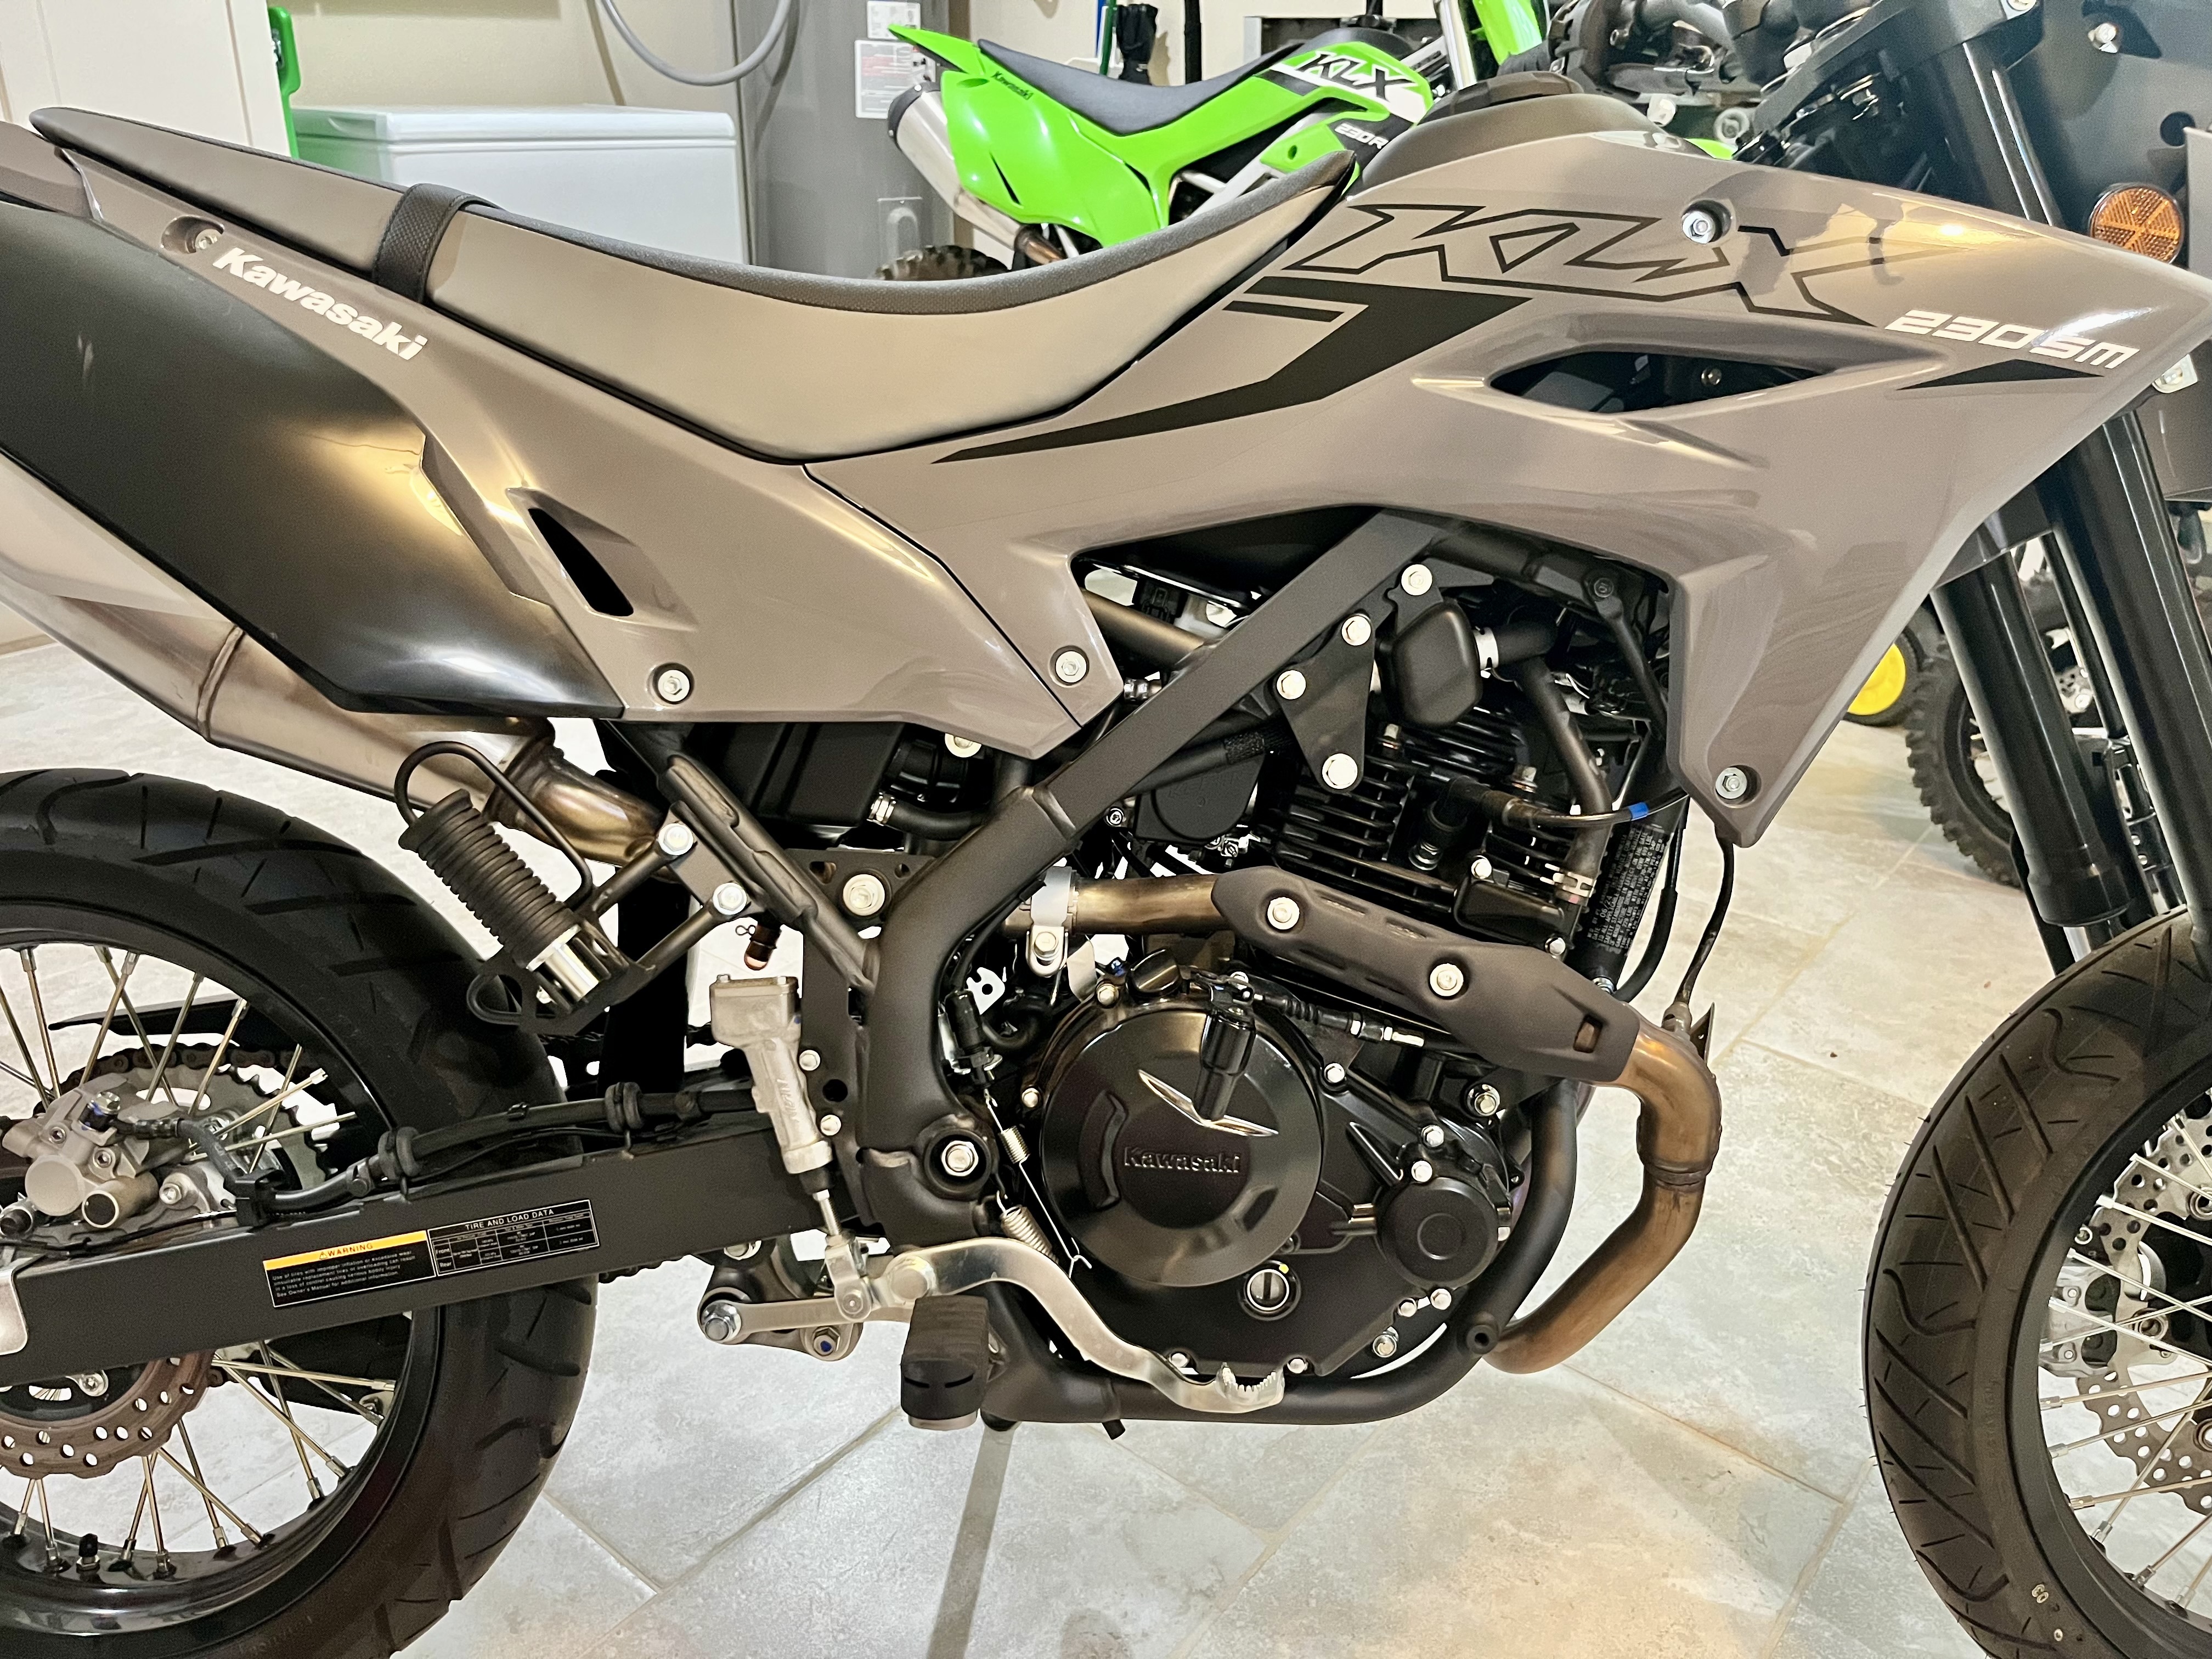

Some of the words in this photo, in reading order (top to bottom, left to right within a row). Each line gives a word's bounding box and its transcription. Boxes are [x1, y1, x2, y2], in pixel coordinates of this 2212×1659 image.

[990, 71, 1034, 100] Kawasaki
[1295, 53, 1417, 103] KLX
[1334, 122, 1389, 149] 230R
[1281, 203, 1976, 328] KLX
[212, 247, 428, 360] Kawasaki
[1599, 894, 1613, 918] 06/24
[1125, 1146, 1240, 1173] Kawasaki
[465, 1222, 484, 1230] TIRE
[487, 1218, 504, 1226] AND
[507, 1214, 529, 1223] LOAD
[532, 1209, 554, 1218] DATA
[328, 1243, 373, 1257] WARNING
